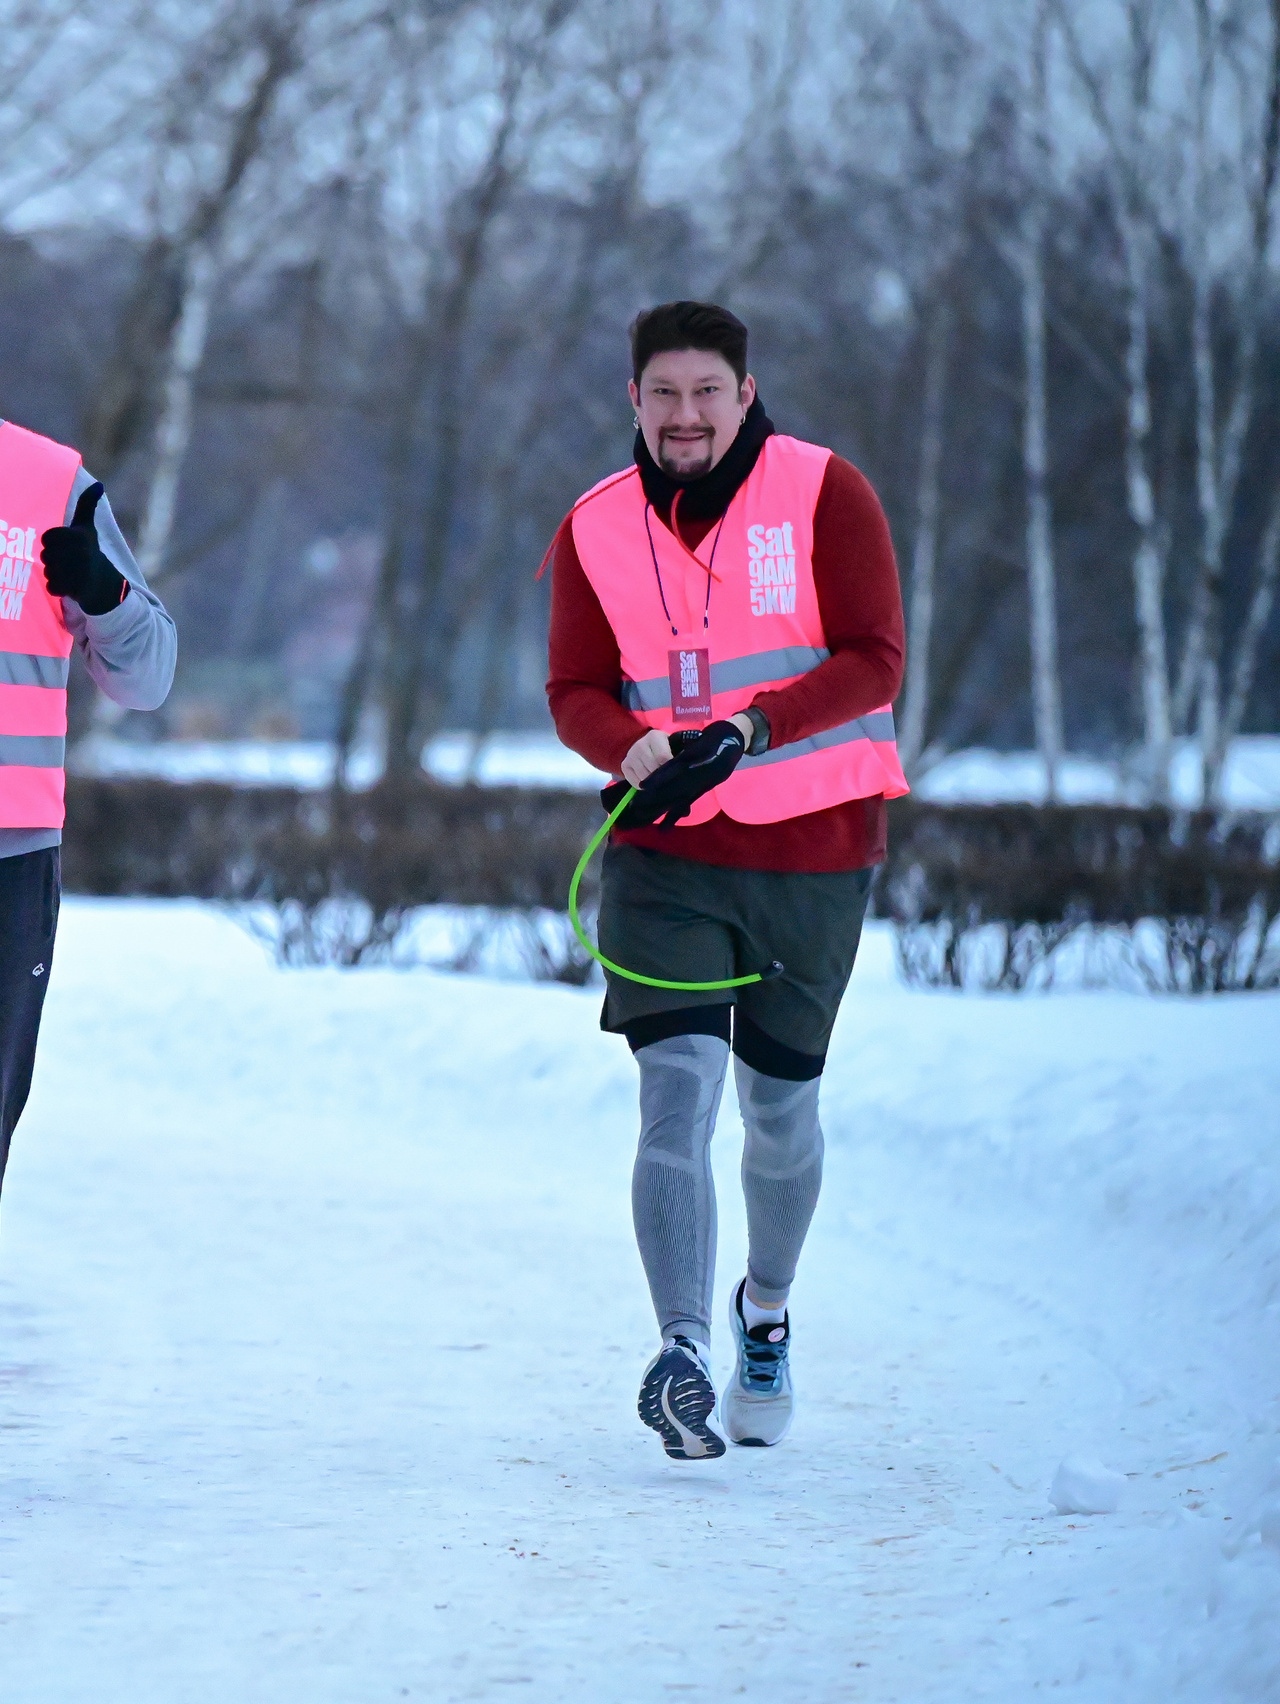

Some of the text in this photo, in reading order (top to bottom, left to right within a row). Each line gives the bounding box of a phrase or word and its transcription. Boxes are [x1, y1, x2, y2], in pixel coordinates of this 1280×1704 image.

[747, 521, 795, 560] Sat
[749, 556, 796, 588] 9AM
[750, 585, 797, 617] 5KM
[679, 651, 697, 670] Sat
[680, 668, 698, 684] 9AM
[681, 682, 699, 698] 5KM
